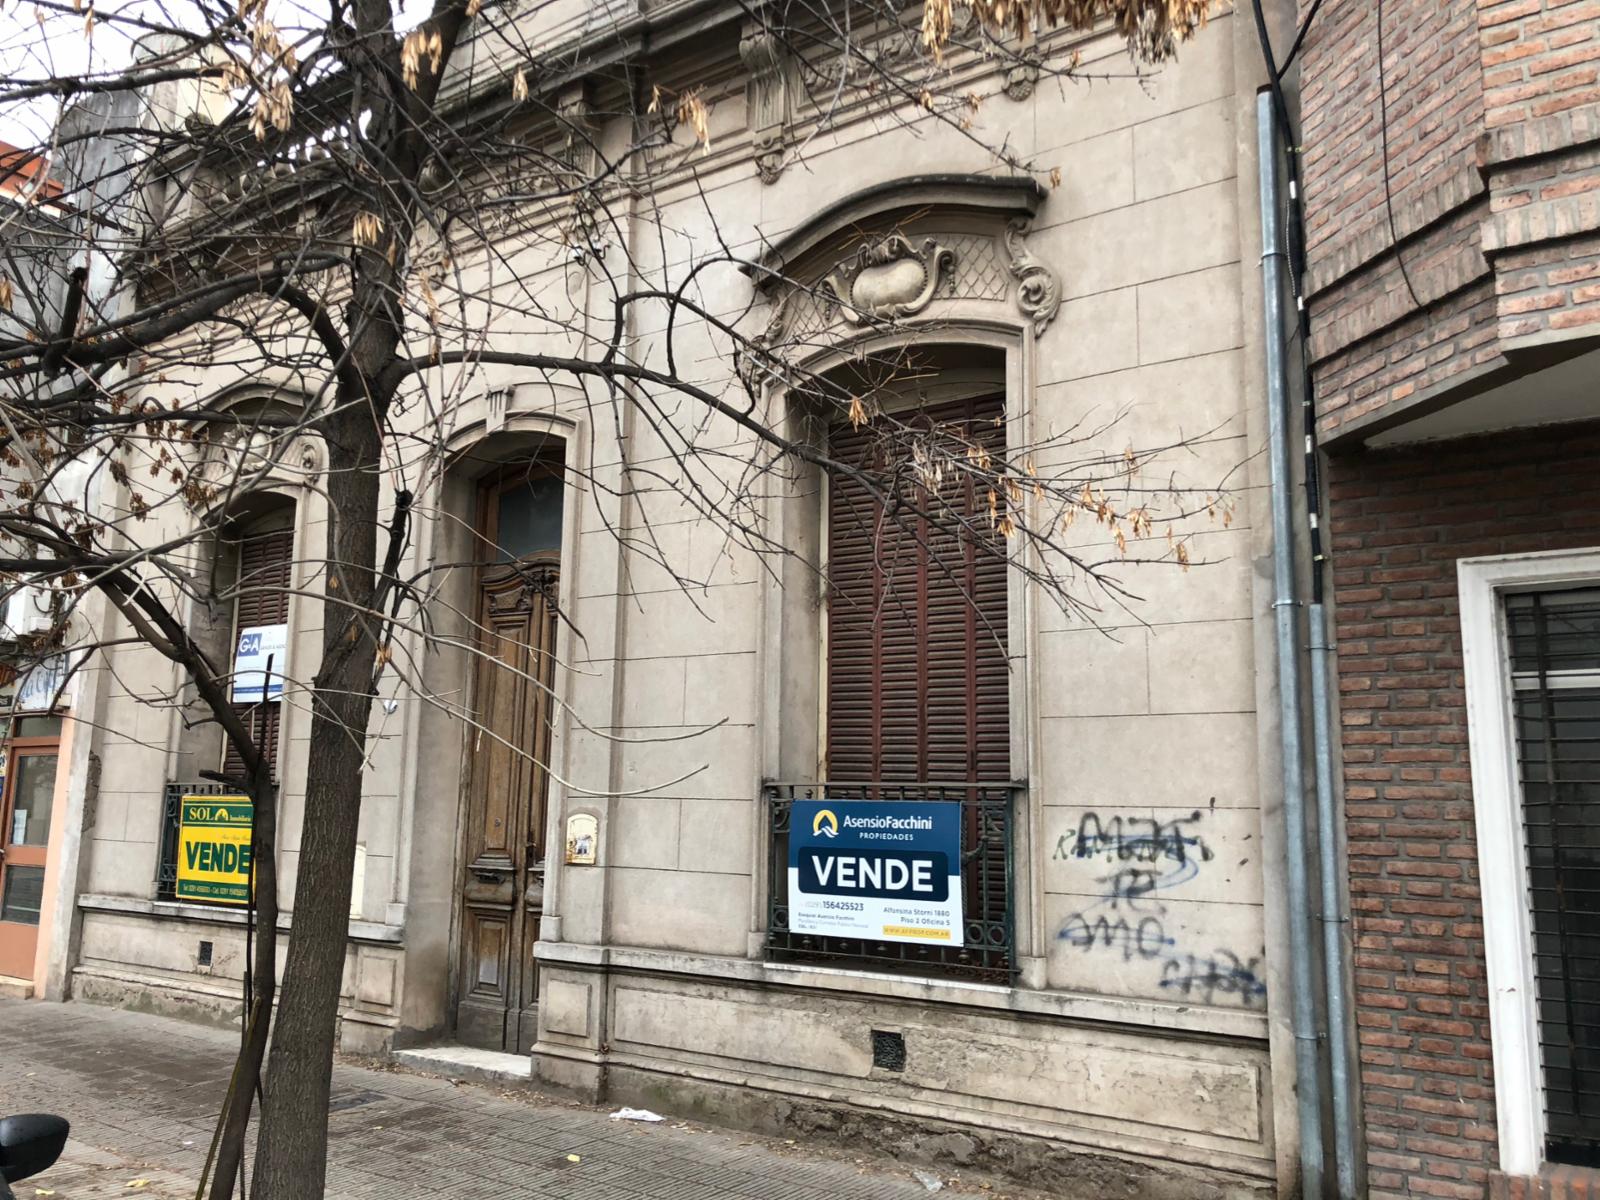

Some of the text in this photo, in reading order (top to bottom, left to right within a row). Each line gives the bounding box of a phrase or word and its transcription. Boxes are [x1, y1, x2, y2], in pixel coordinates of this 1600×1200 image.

[843, 815, 933, 830] AsensioFacchini
[859, 832, 914, 841] PROPIEDADES
[185, 841, 251, 874] VENDE
[811, 855, 934, 892] VENDE
[822, 900, 864, 911] 156425523
